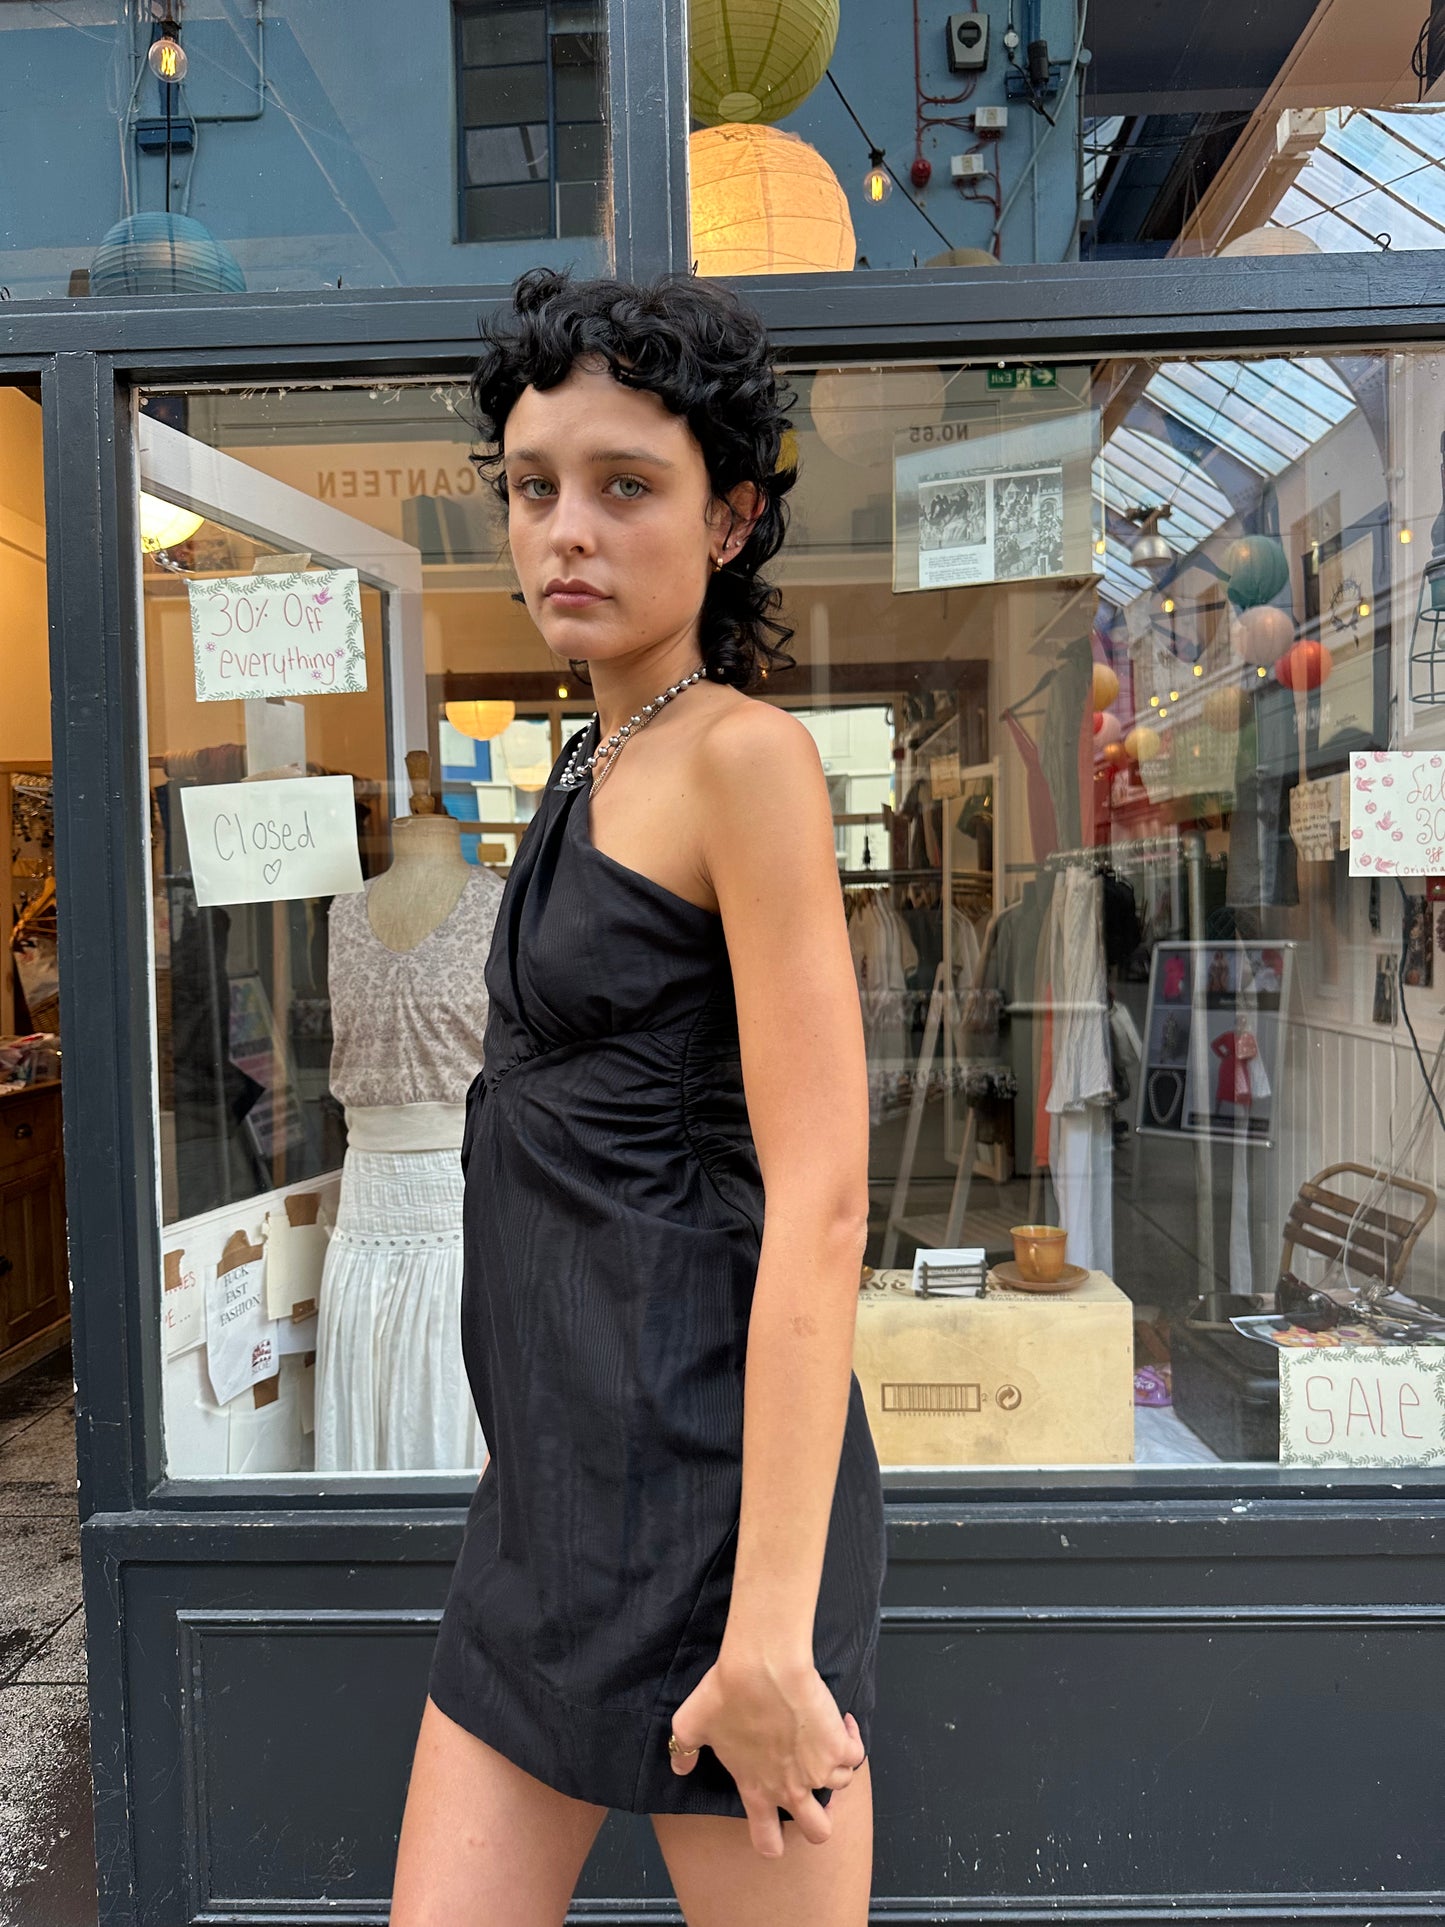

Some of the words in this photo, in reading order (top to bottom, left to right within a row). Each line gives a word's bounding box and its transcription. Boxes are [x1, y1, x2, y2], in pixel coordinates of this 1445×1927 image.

[210, 592, 269, 637] 30%
[283, 594, 324, 634] Off
[219, 650, 338, 687] everything
[213, 811, 315, 861] Closed
[1425, 847, 1444, 864] off
[224, 1265, 249, 1287] FUCK
[226, 1282, 248, 1304] FAST
[220, 1294, 260, 1326] FASHION
